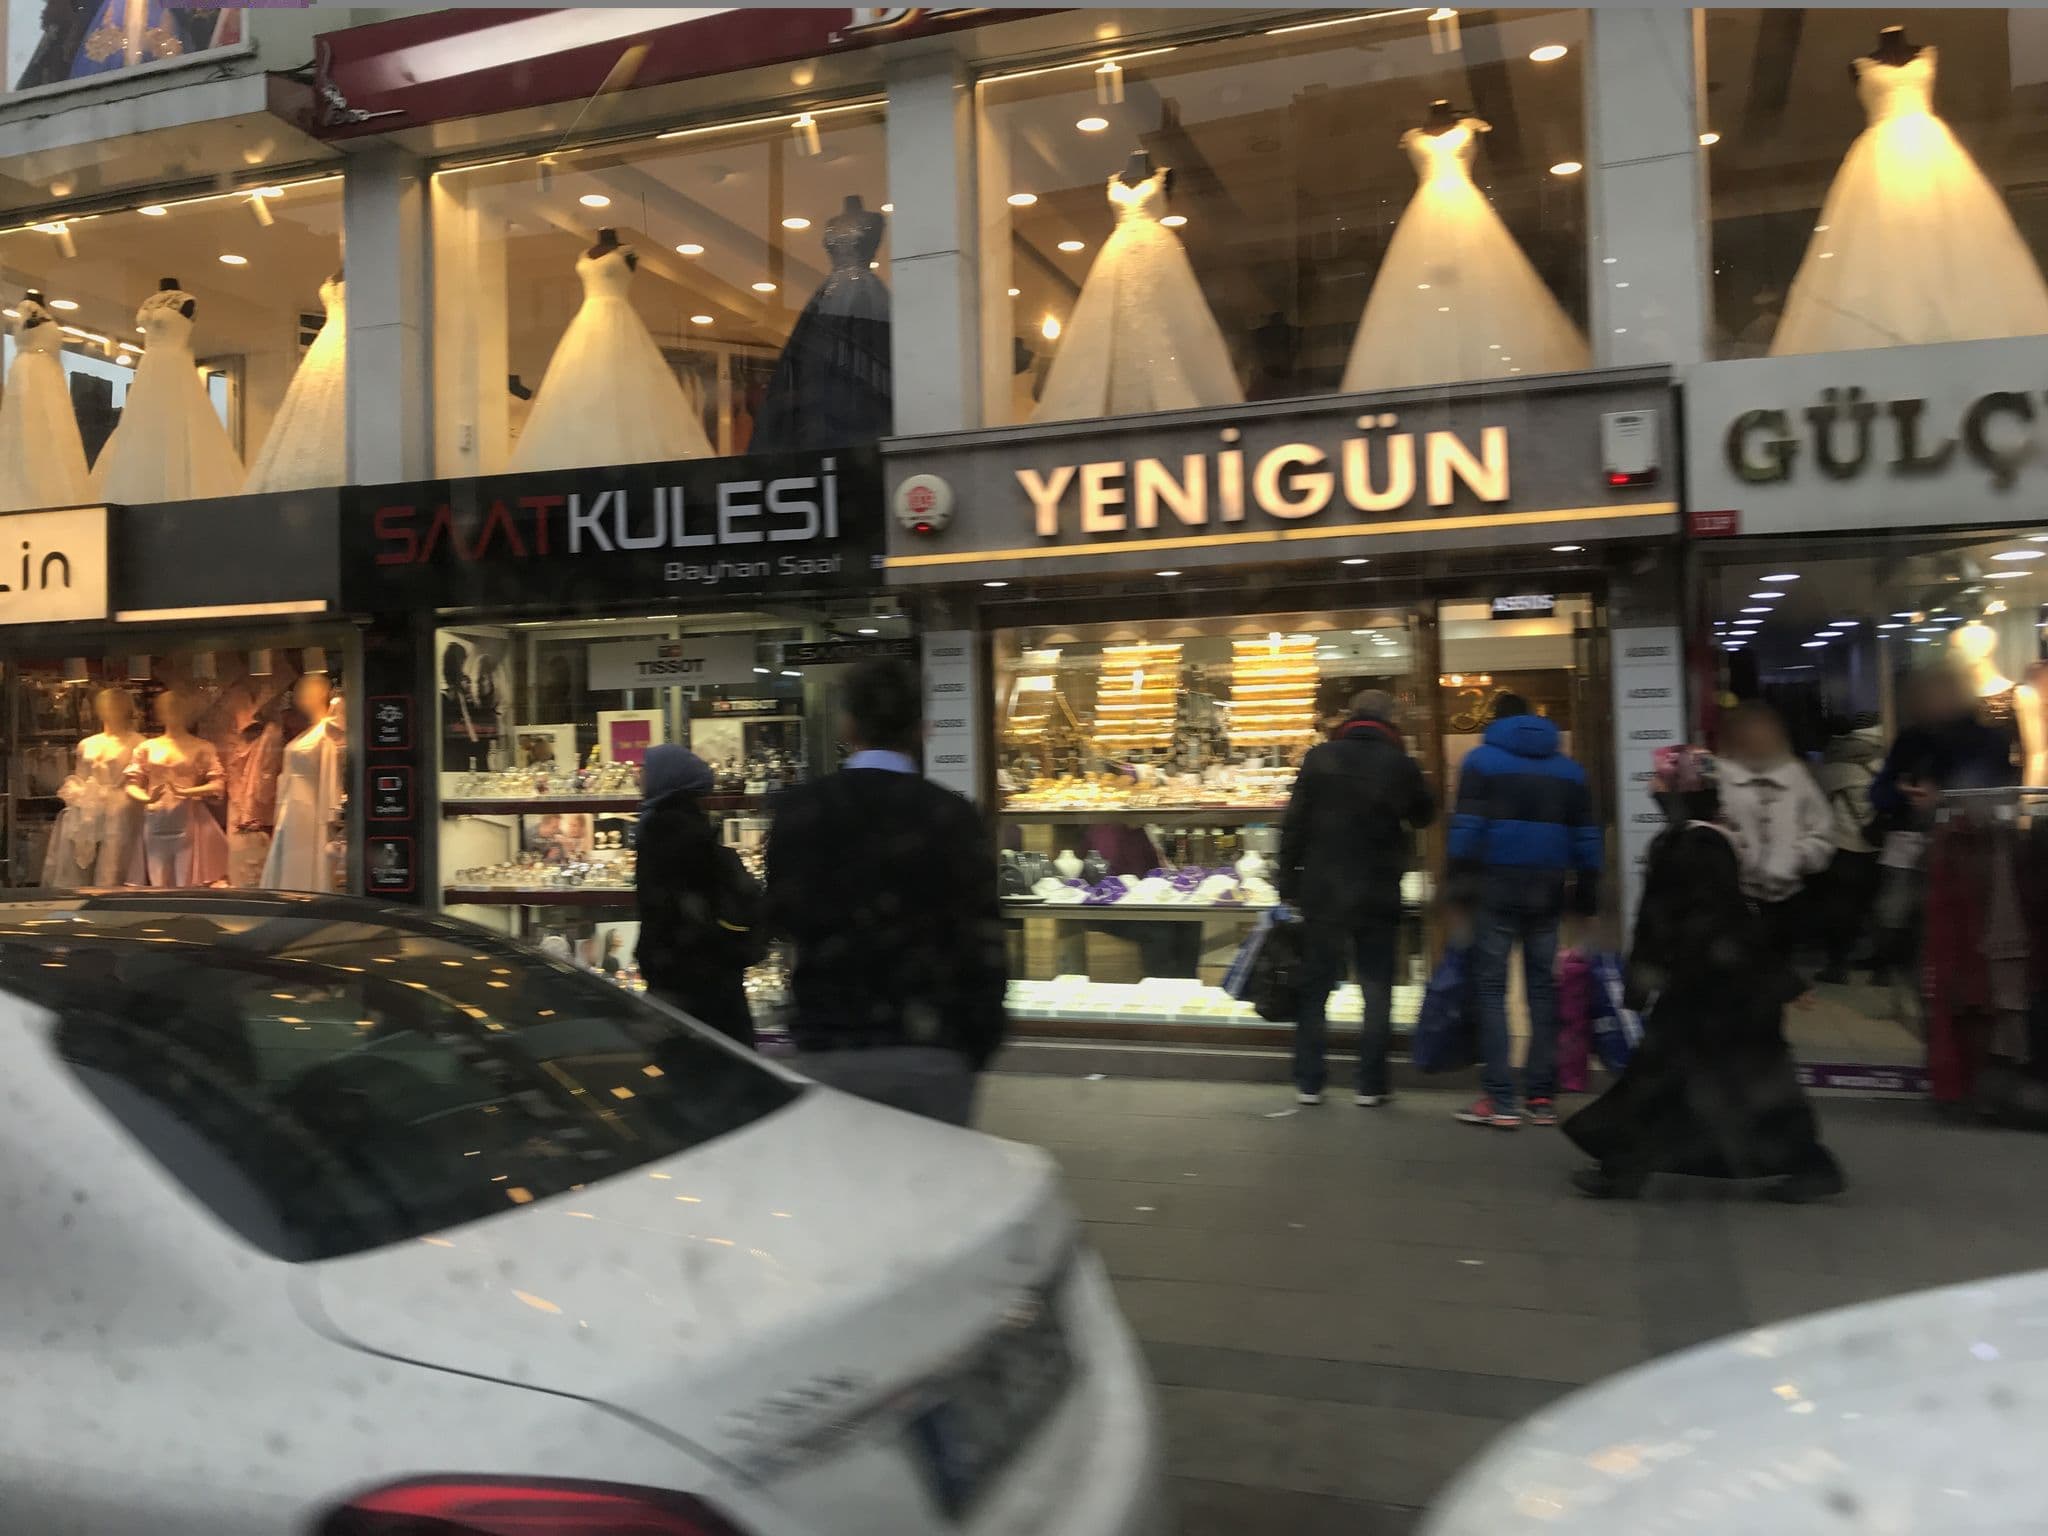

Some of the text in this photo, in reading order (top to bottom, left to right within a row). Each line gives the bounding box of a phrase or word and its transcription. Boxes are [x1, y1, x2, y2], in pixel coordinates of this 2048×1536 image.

[1015, 411, 1512, 537] YENİGÜN
[1723, 385, 2048, 495] GÜLÇ
[664, 558, 770, 585] Bayhan
[635, 658, 706, 675] TISSOT
